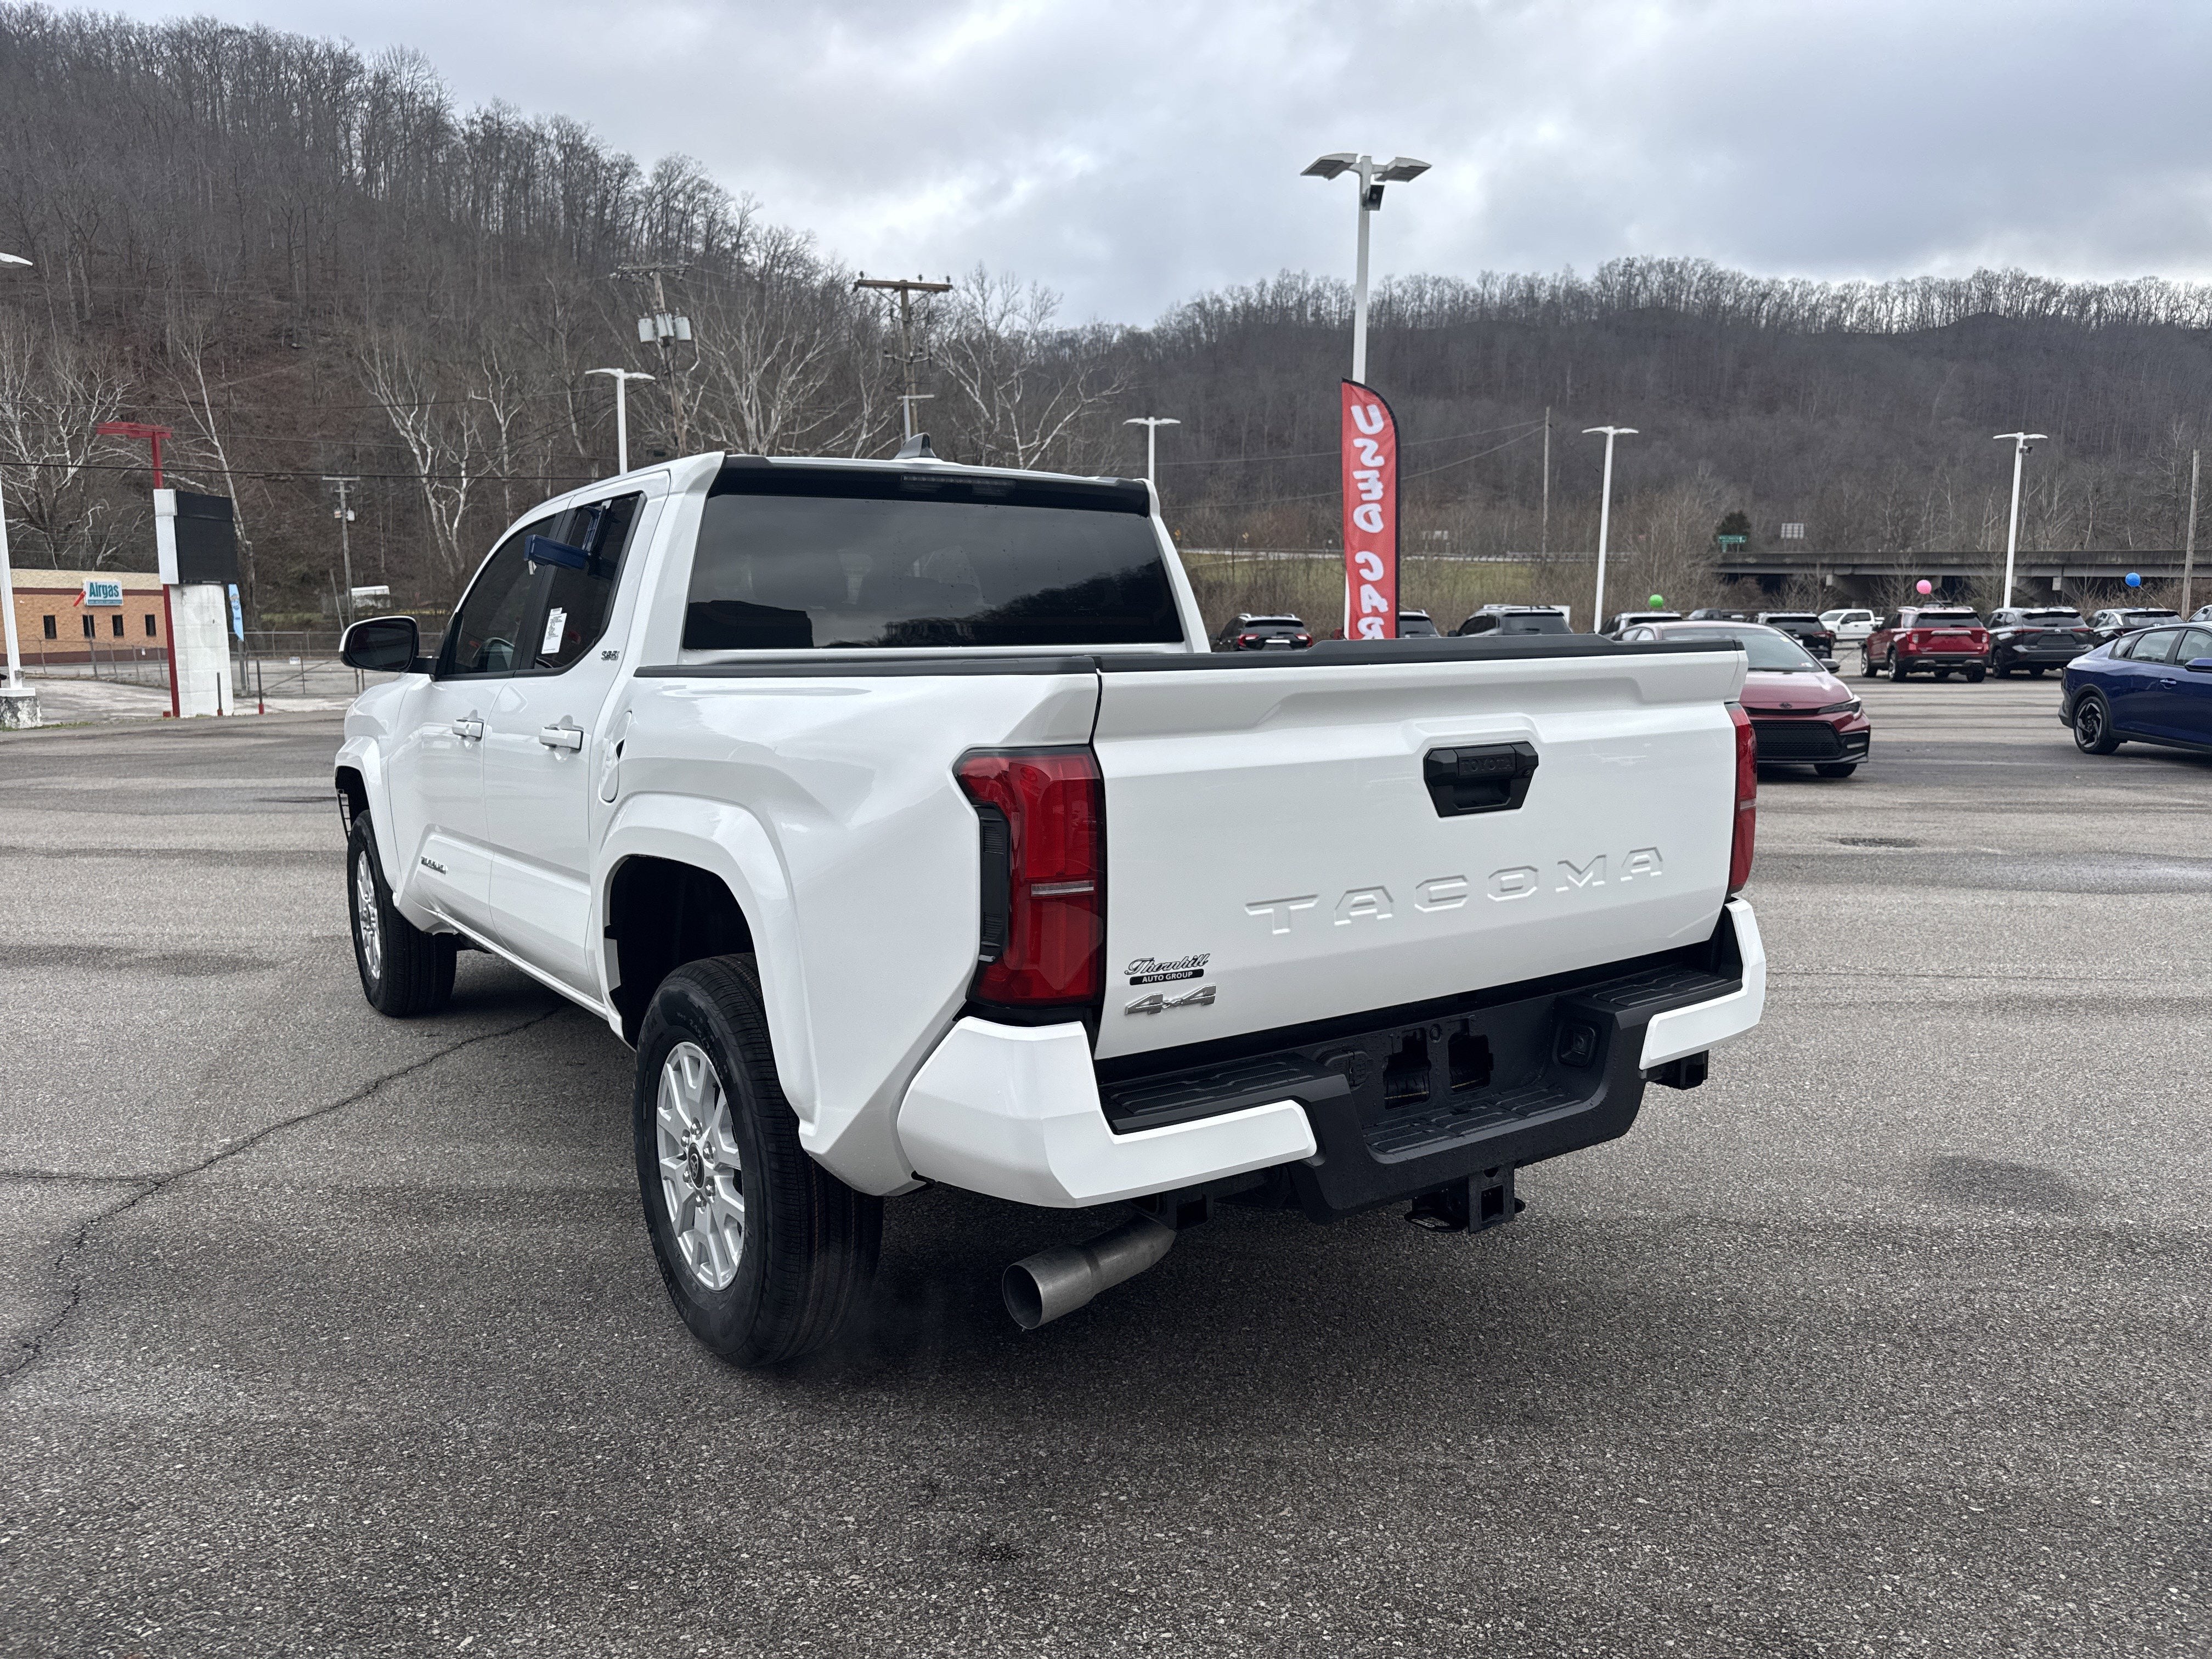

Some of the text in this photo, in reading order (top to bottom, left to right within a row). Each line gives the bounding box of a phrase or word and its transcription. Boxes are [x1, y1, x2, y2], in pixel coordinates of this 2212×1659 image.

[89, 582, 119, 599] Airgas
[1244, 846, 1664, 935] TACOMA
[1125, 953, 1211, 975] Thornhill
[1142, 971, 1193, 983] AUTO GROUP
